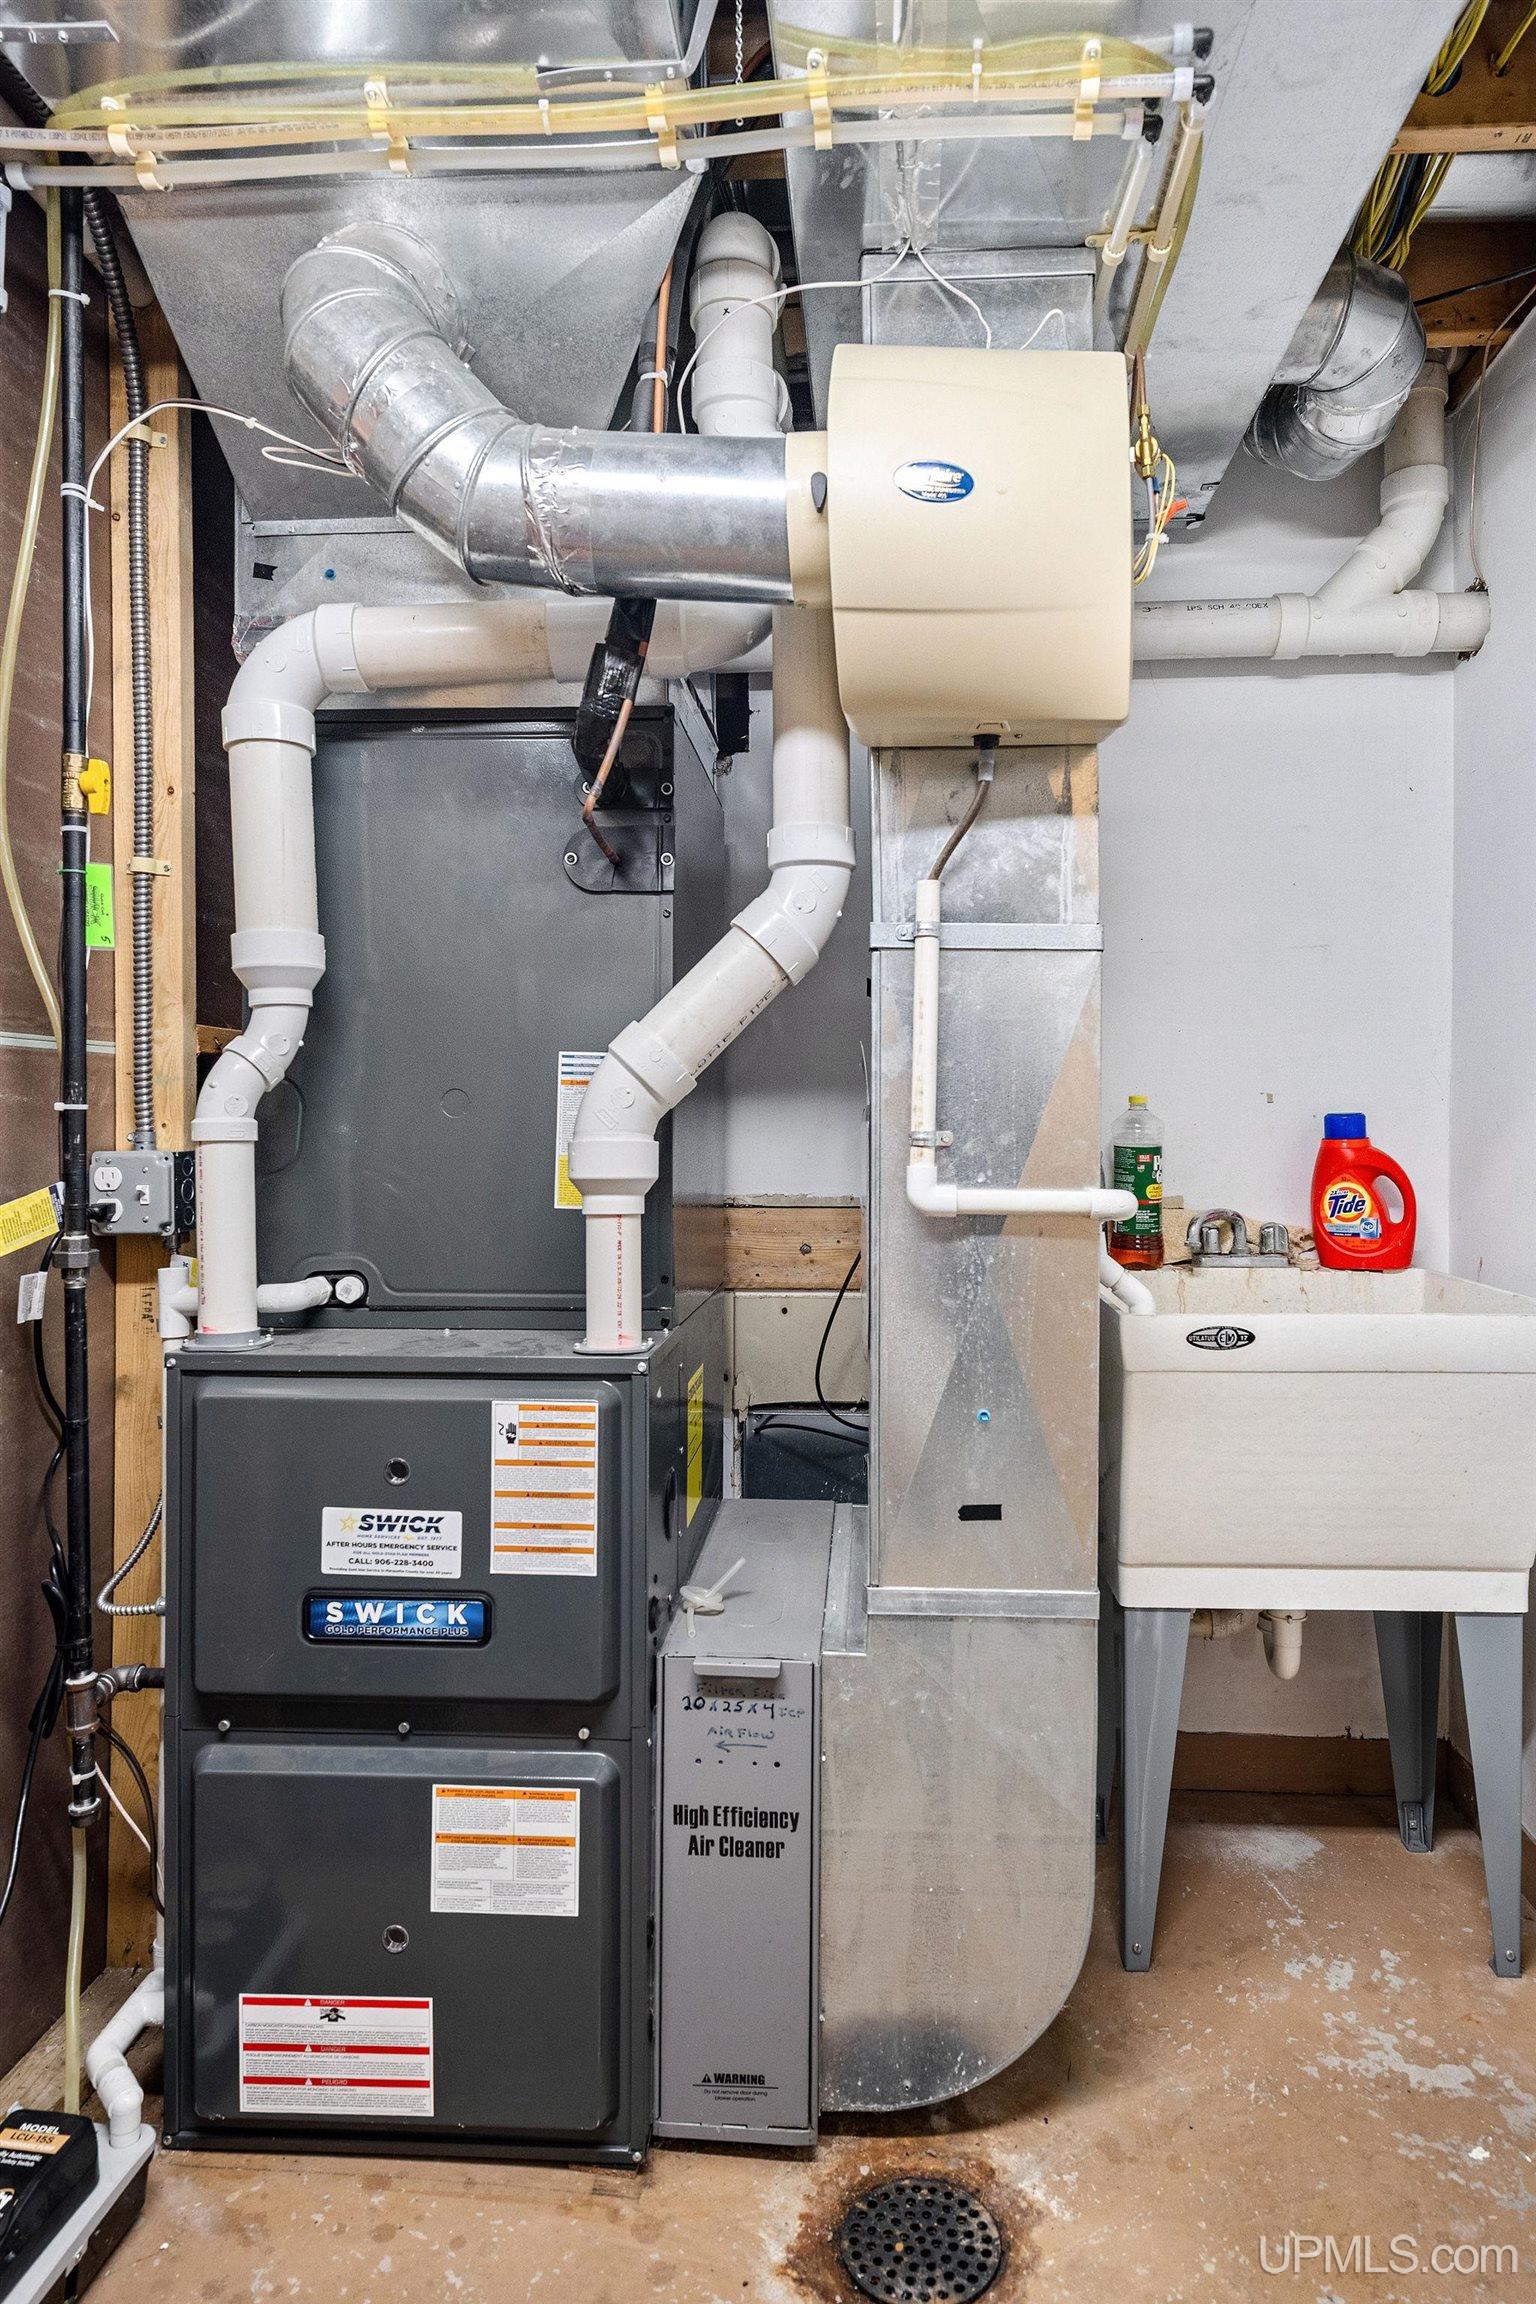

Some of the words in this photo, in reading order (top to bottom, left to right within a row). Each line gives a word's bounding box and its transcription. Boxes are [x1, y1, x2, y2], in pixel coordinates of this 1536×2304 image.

[1207, 603, 1225, 612] SCH
[1328, 1194, 1366, 1218] Tide
[358, 1514, 445, 1534] SWICK
[379, 1543, 425, 1551] EMERGENCY
[426, 1544, 458, 1552] SERVICE
[374, 1558, 434, 1567] 906-228-3400
[325, 1601, 468, 1625] SWICK
[325, 1625, 356, 1635] GOLD
[357, 1625, 439, 1637] PERFORMANCE
[440, 1626, 469, 1637] PLUS
[681, 1695, 706, 1711] 20
[722, 1700, 745, 1713] 25
[763, 1703, 775, 1720] 4
[673, 1804, 709, 1829] High
[713, 1806, 800, 1833] Efficiency
[687, 1835, 715, 1856] Air
[719, 1836, 785, 1859] Cleaner
[713, 2073, 766, 2086] WARNING
[19, 2122, 61, 2135] MODEL
